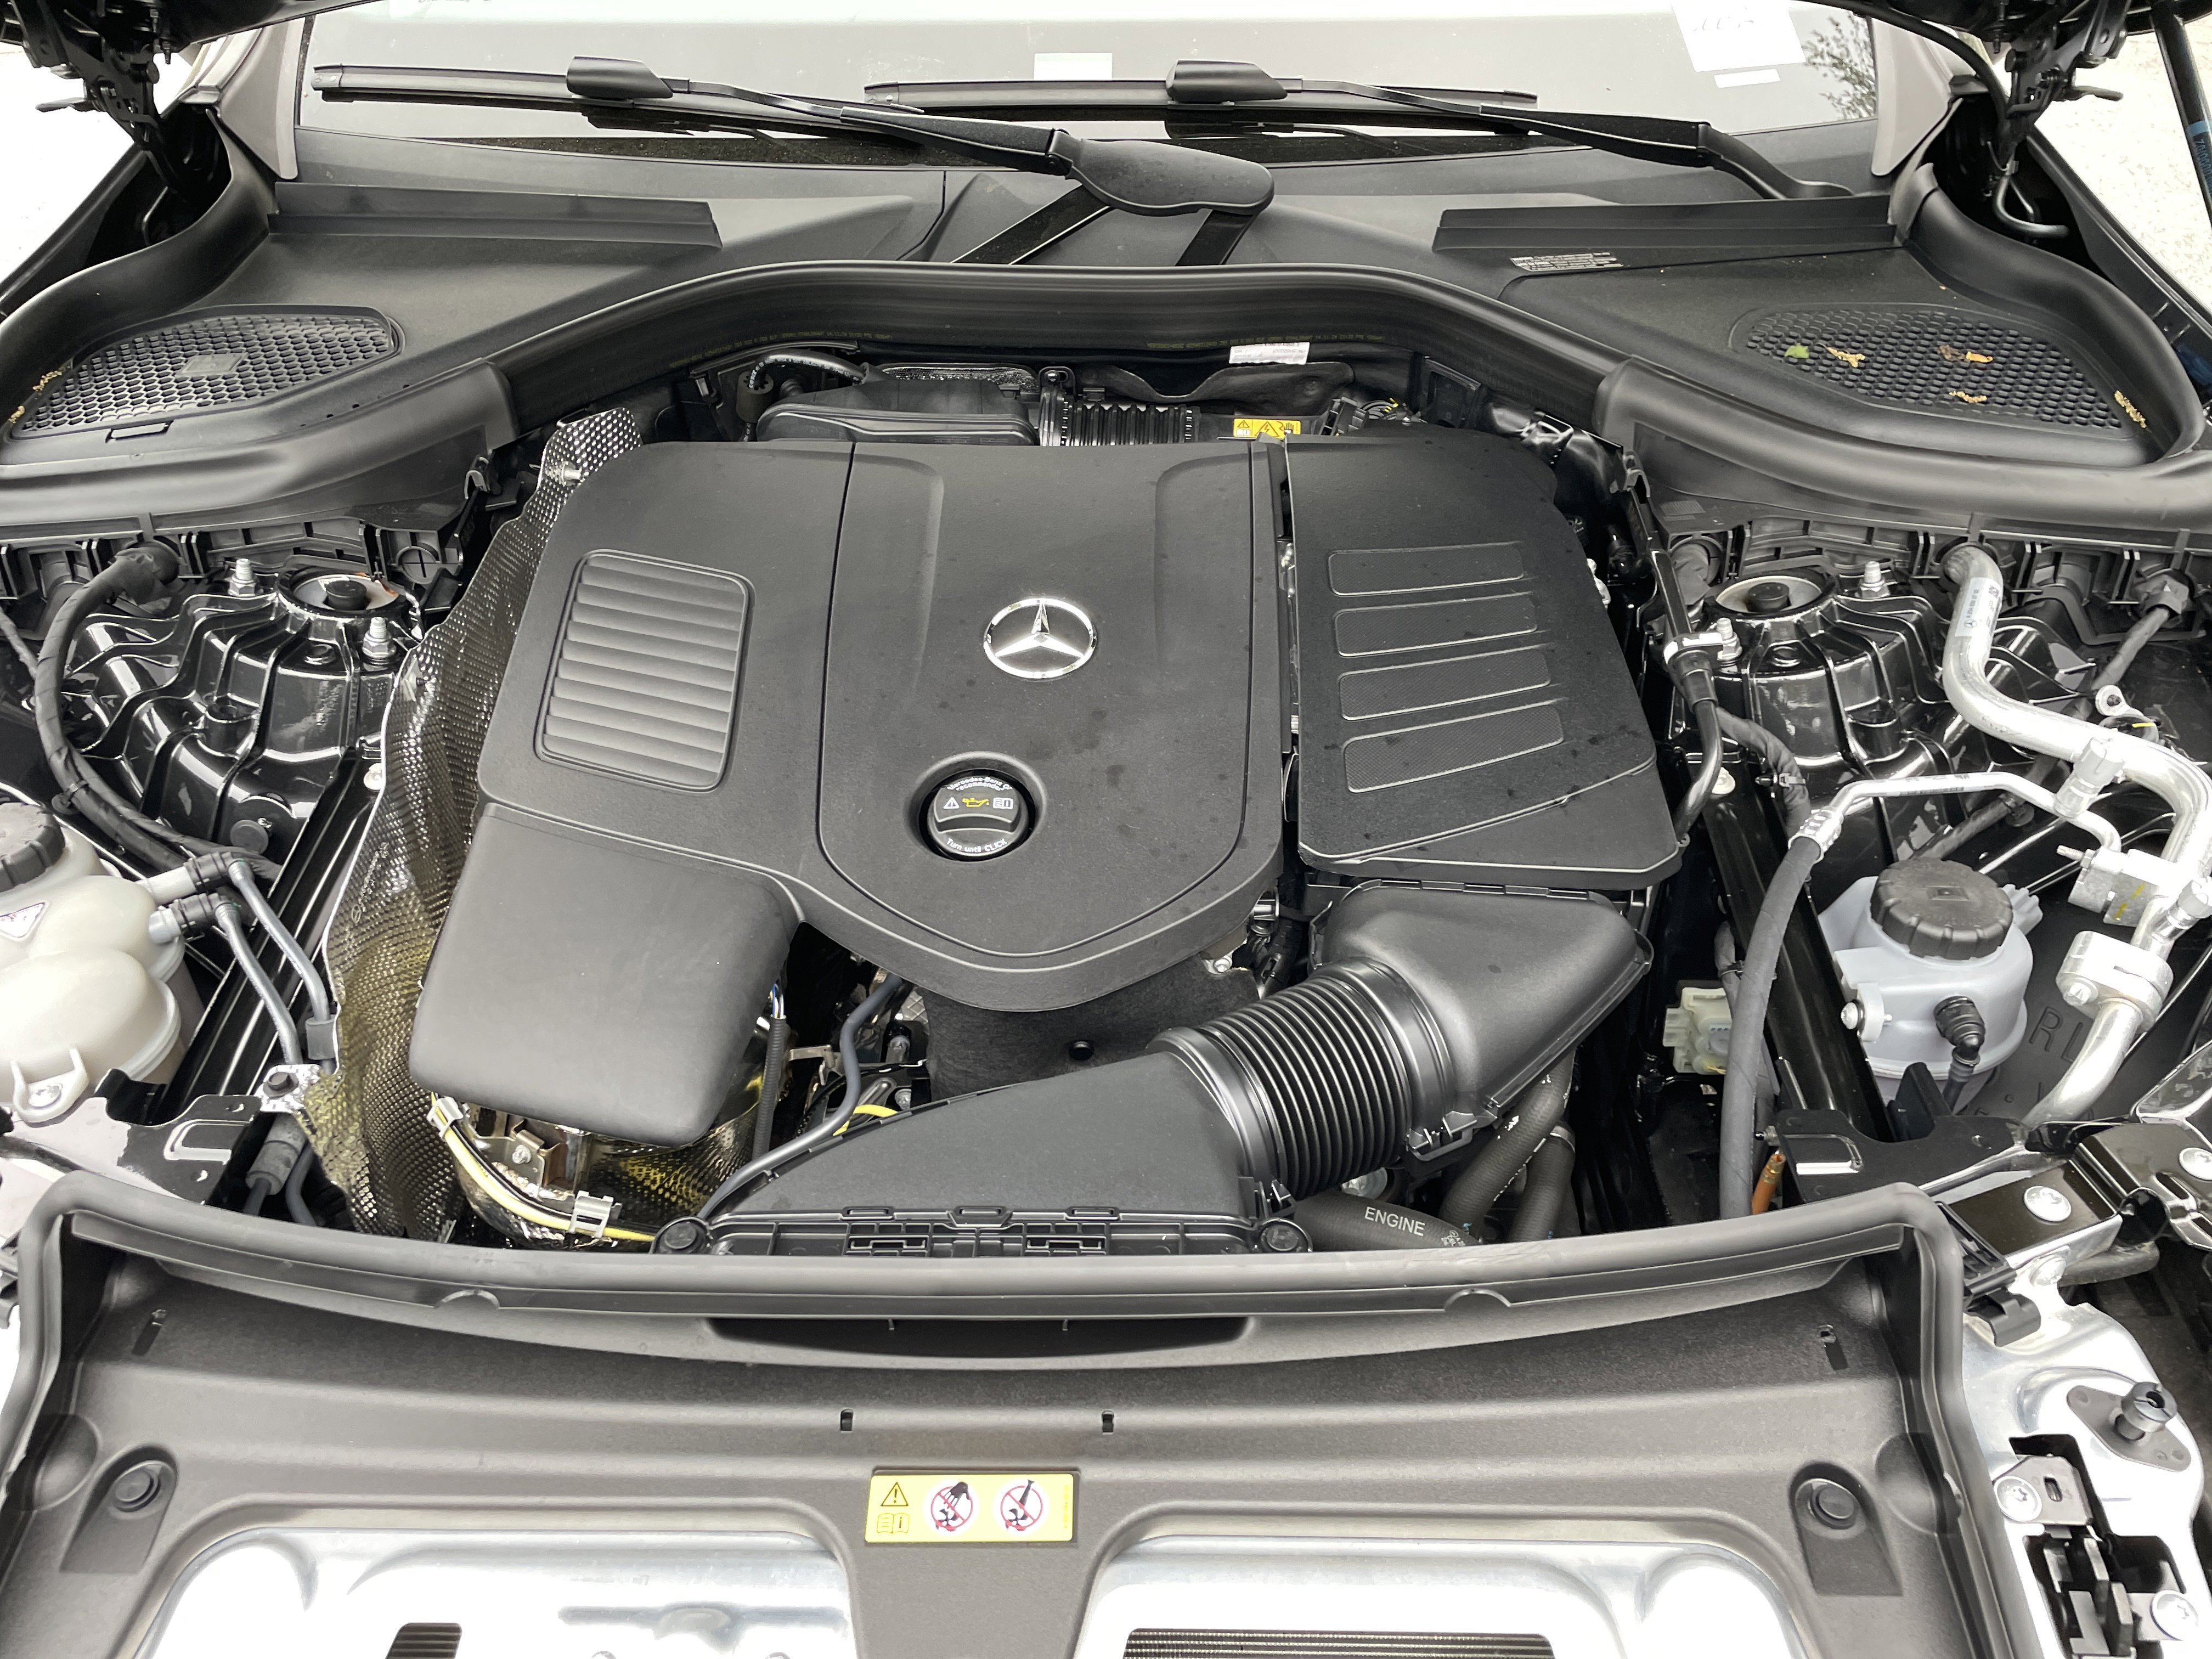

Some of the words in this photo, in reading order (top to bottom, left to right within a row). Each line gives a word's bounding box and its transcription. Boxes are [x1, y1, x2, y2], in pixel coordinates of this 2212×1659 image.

[946, 776, 1003, 790] Mercedes-Benz
[946, 838, 962, 851] Turn
[984, 838, 1008, 852] CLICK
[1364, 1206, 1426, 1237] ENGINE
